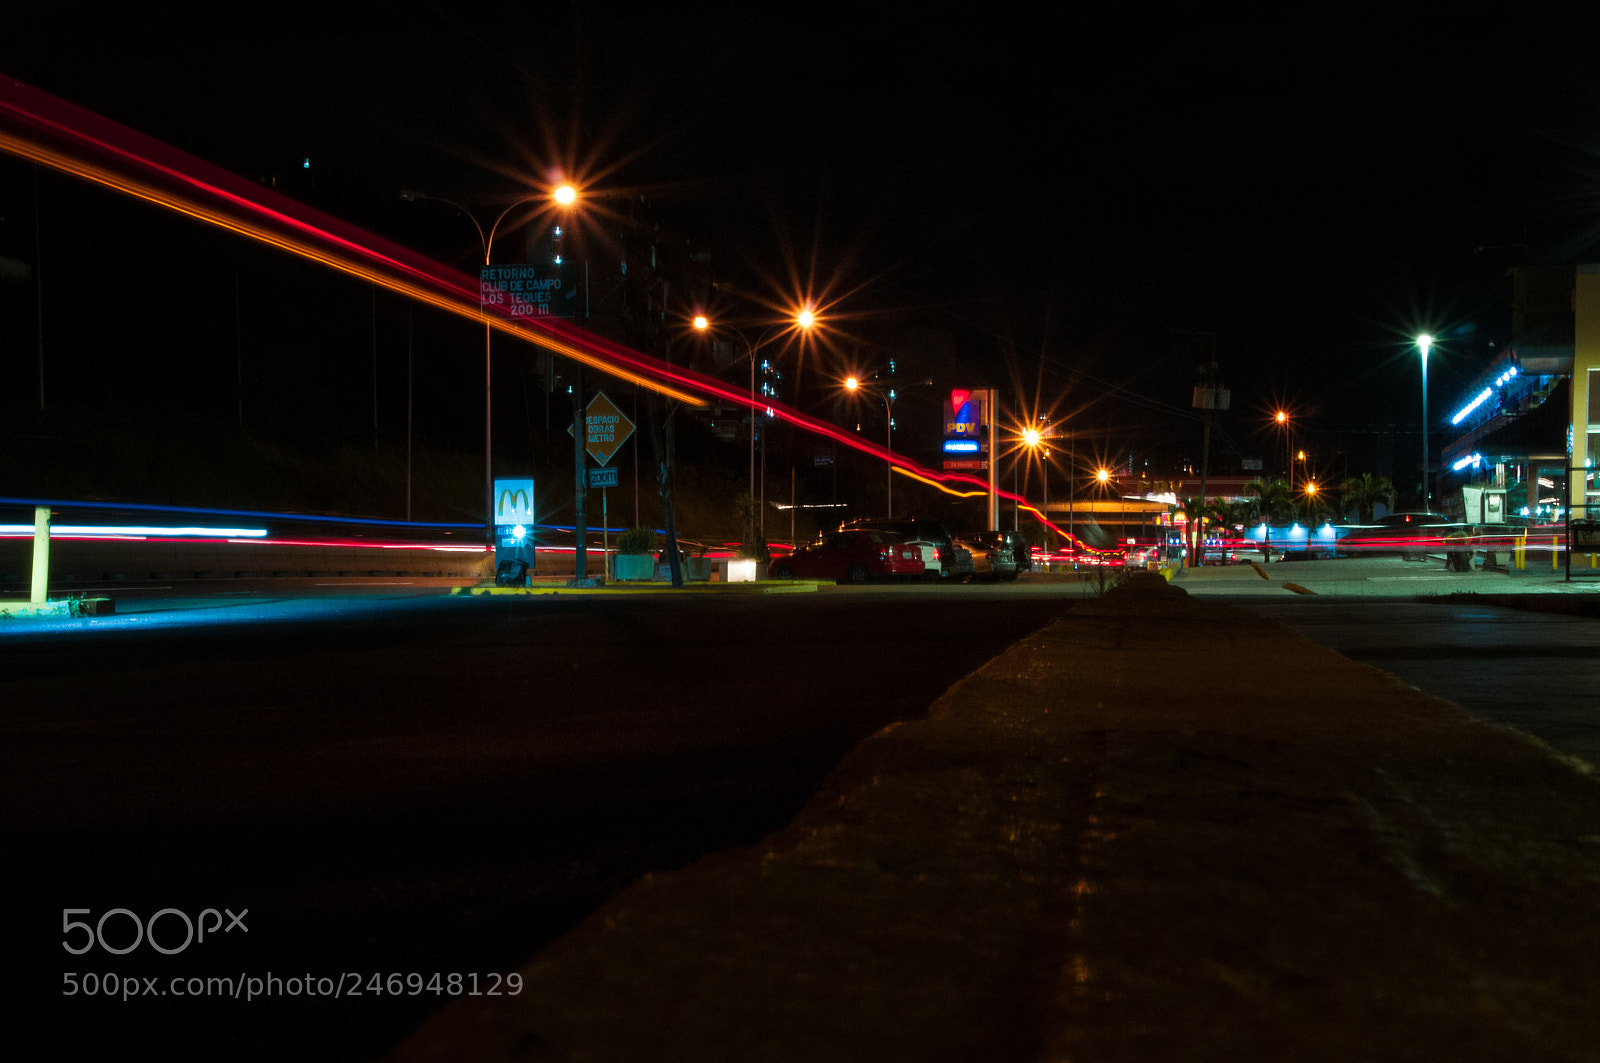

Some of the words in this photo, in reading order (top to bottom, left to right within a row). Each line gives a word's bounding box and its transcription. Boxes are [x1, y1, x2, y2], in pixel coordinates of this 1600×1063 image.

[481, 267, 535, 280] RETORNO
[482, 281, 508, 292] CLUB
[510, 280, 523, 291] DE
[526, 279, 561, 291] CAMPO
[482, 294, 504, 305] LOS
[509, 291, 552, 304] TEQUES
[510, 304, 533, 316] 200
[588, 425, 615, 434] OBRAS
[946, 423, 976, 433] PDV
[588, 434, 615, 443] METRO
